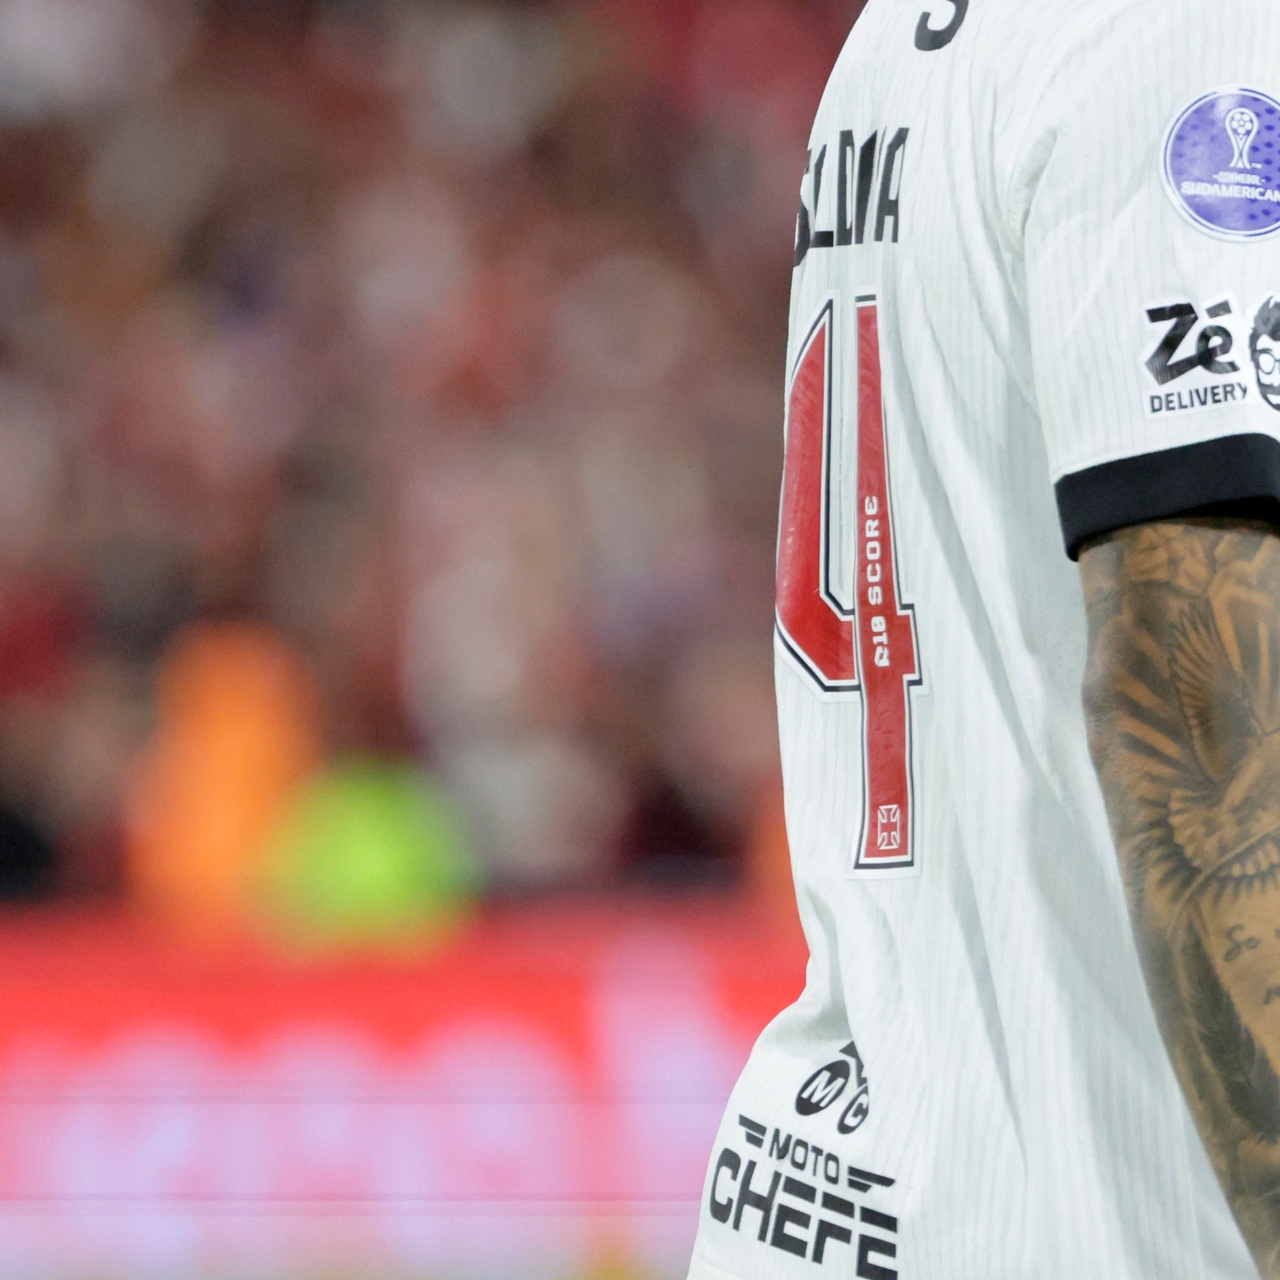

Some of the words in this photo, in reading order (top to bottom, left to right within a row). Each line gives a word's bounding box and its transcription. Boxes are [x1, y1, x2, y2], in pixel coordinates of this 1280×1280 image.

[1150, 382, 1248, 414] DELIVERY
[775, 294, 924, 870] 4
[864, 495, 884, 606] SCORE
[768, 1127, 840, 1185] MOTO
[709, 1147, 898, 1280] CHEFE
